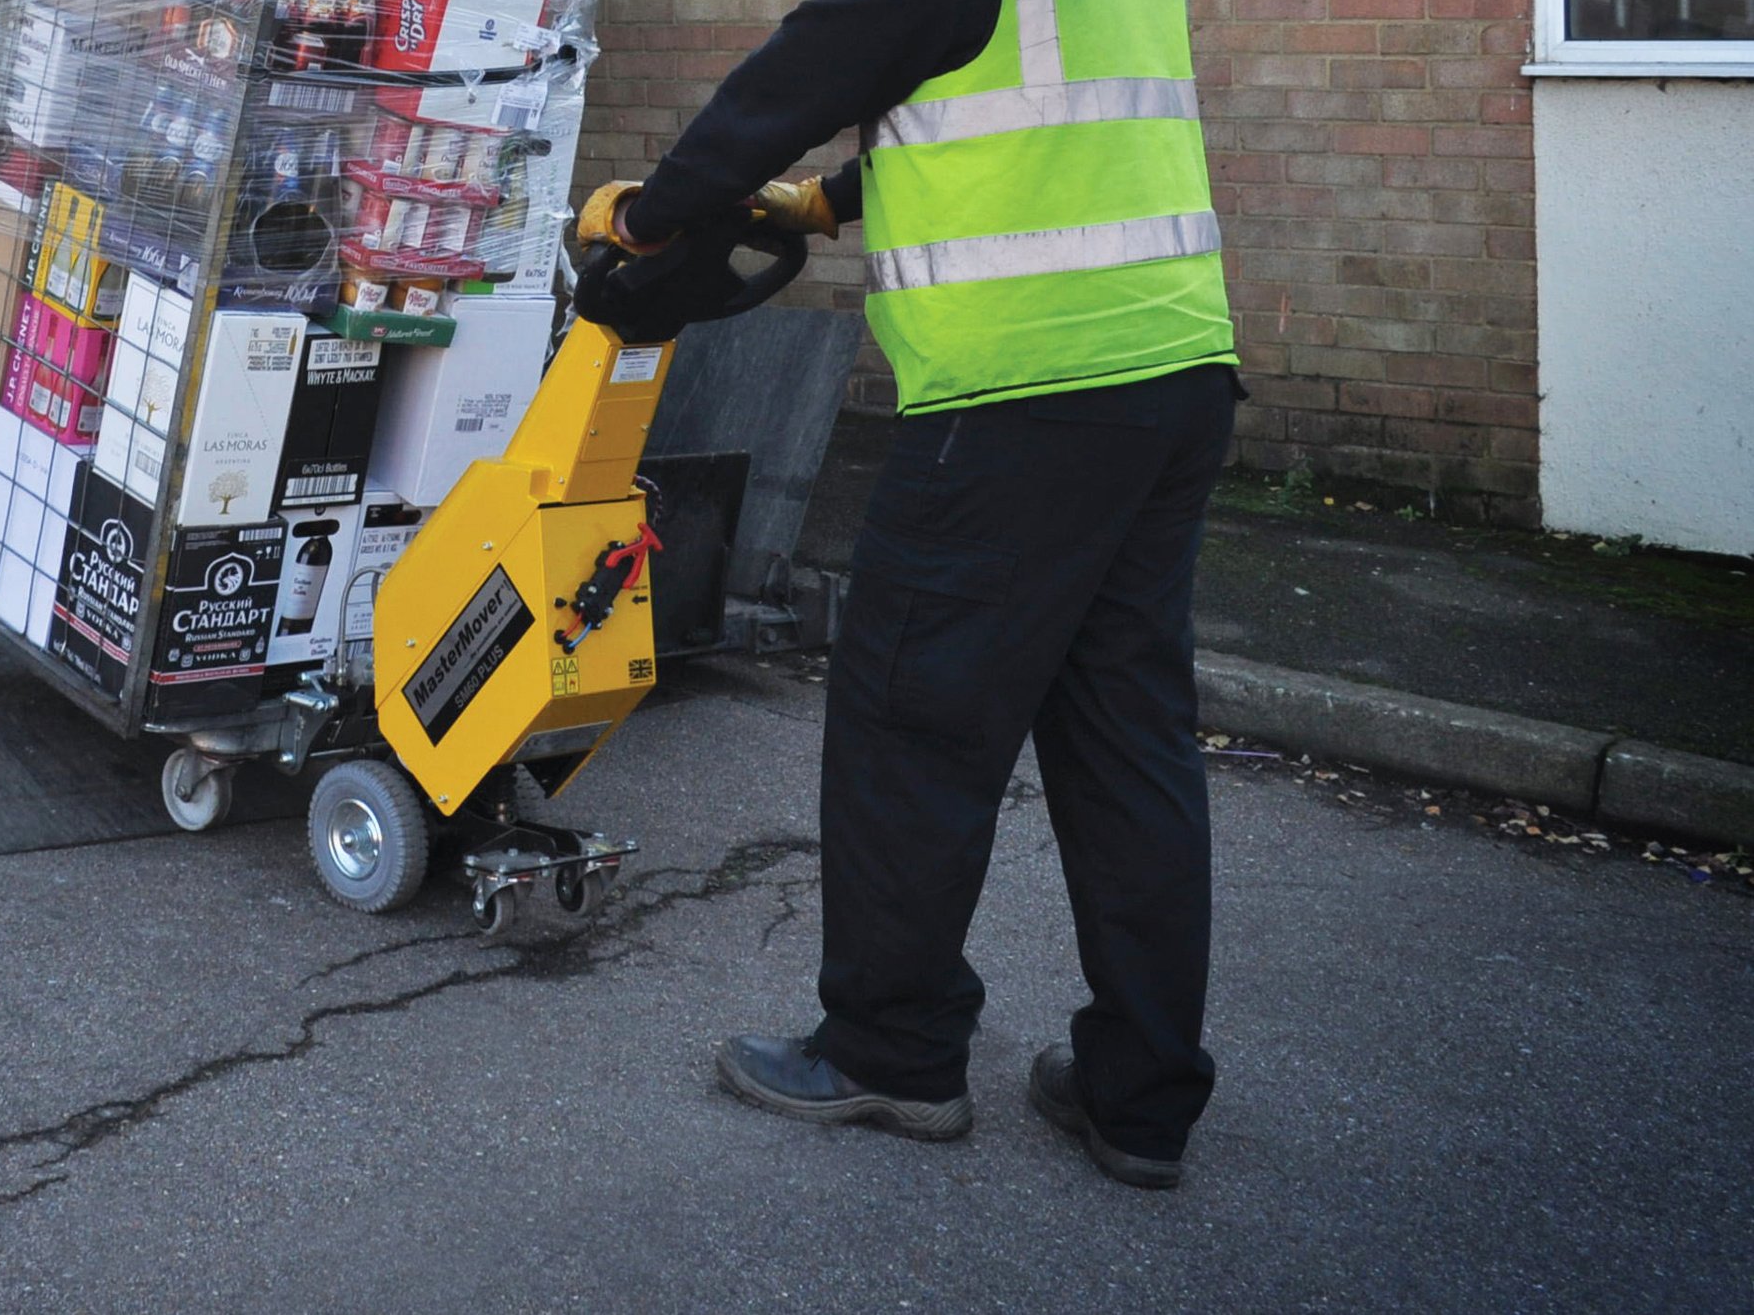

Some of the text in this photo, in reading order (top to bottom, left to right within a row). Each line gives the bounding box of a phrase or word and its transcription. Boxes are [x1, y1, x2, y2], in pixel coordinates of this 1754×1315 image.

[31, 185, 52, 255] CHENET
[283, 284, 318, 304] 1664
[154, 328, 186, 353] MORA
[6, 374, 19, 404] J.P.
[204, 439, 268, 453] LAS MORAS
[227, 431, 249, 440] FINCA
[69, 552, 140, 616] СТАНДАР
[185, 628, 256, 643] RUSSIAN STANDARD
[412, 586, 505, 709] MasterMover
[196, 651, 237, 662] VODKA
[454, 644, 505, 709] SM60 PLUS
